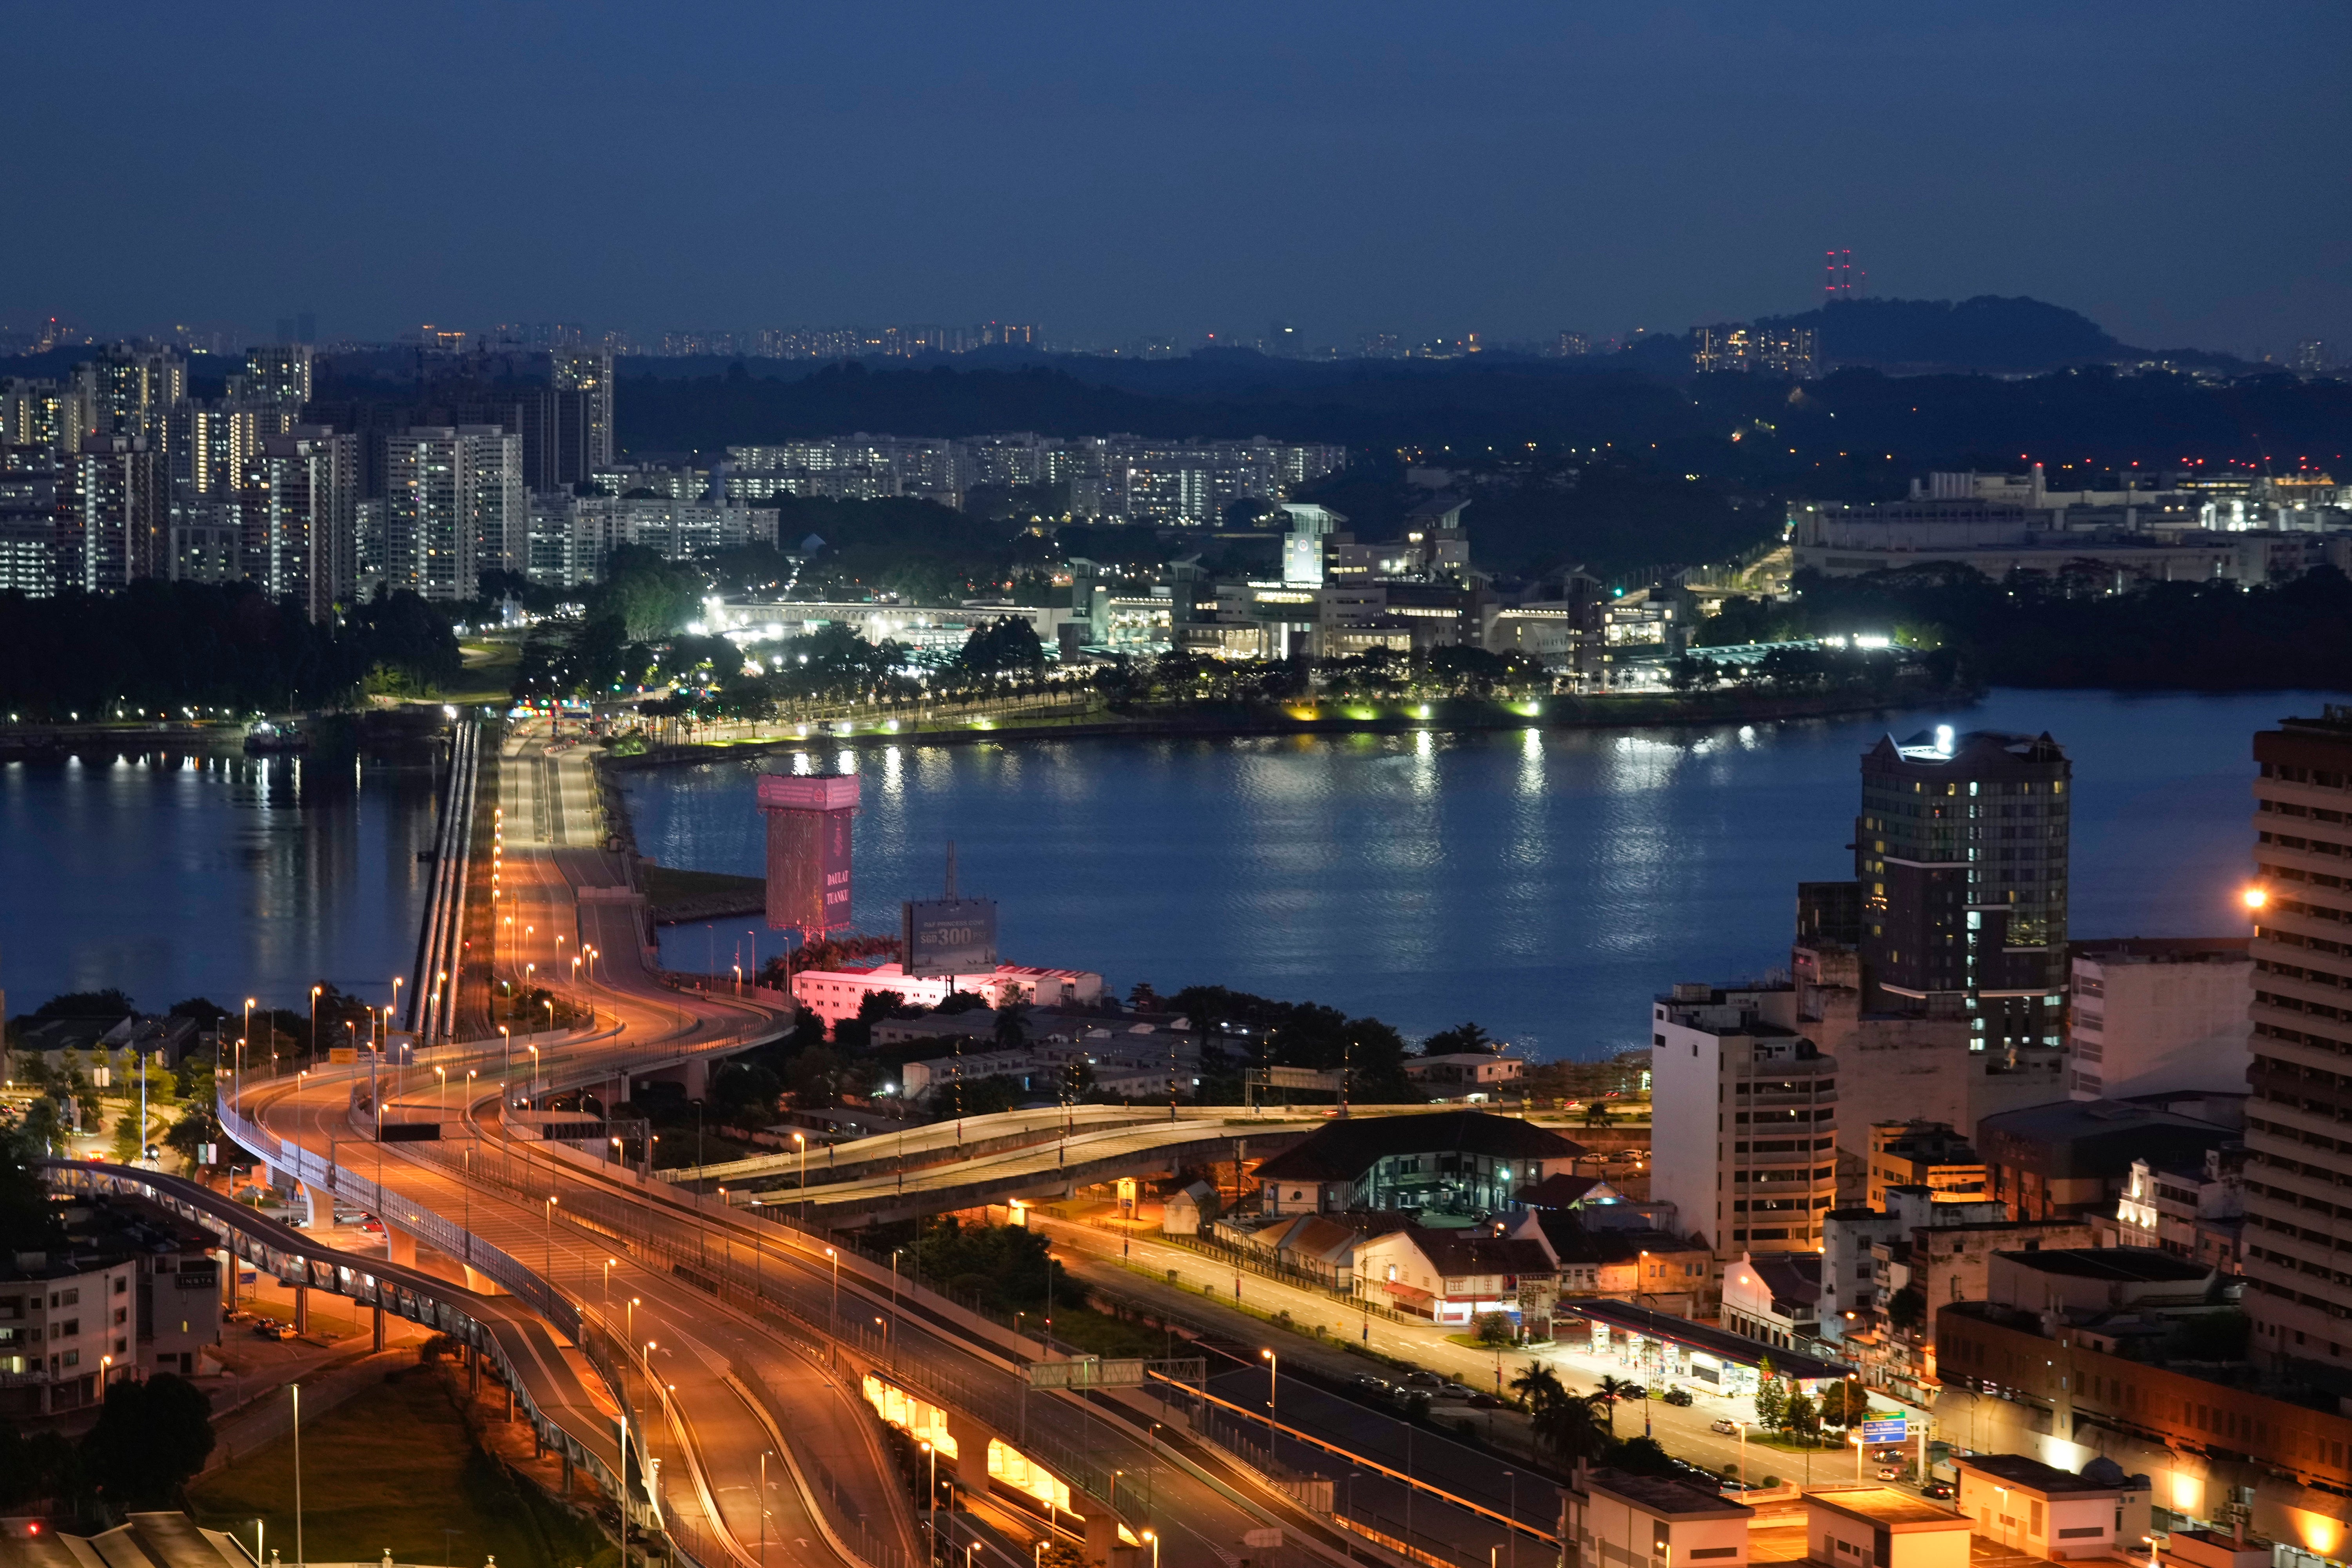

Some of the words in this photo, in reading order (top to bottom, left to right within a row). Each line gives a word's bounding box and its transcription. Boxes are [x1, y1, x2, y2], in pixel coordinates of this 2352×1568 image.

[828, 870, 849, 886] DAULAT
[826, 889, 849, 905] TUANKU
[921, 935, 937, 944] SGD
[938, 927, 972, 946] 300
